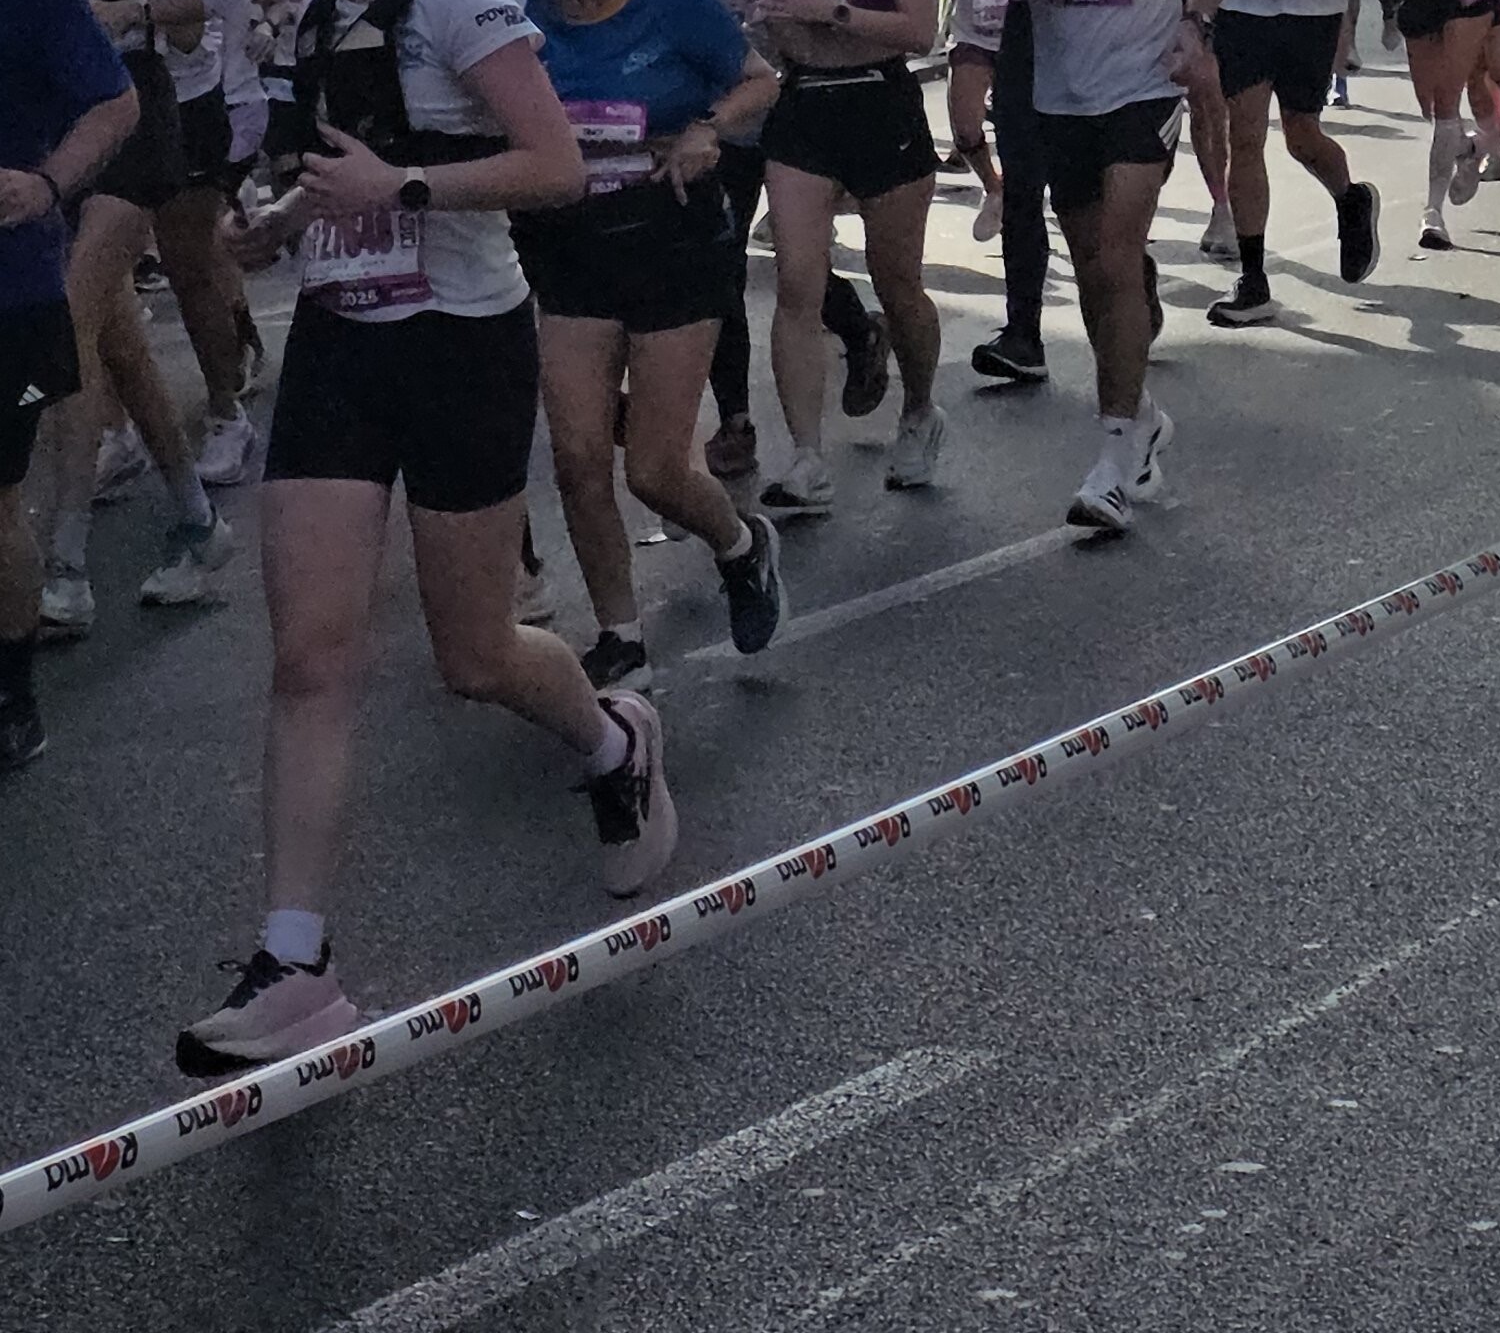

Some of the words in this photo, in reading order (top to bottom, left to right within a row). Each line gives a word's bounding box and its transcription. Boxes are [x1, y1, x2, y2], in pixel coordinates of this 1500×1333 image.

[510, 953, 580, 998] Roma
[408, 993, 482, 1040] Roma
[297, 1037, 376, 1087] Roma
[175, 1083, 263, 1137] Roma
[43, 1131, 139, 1192] Roma
